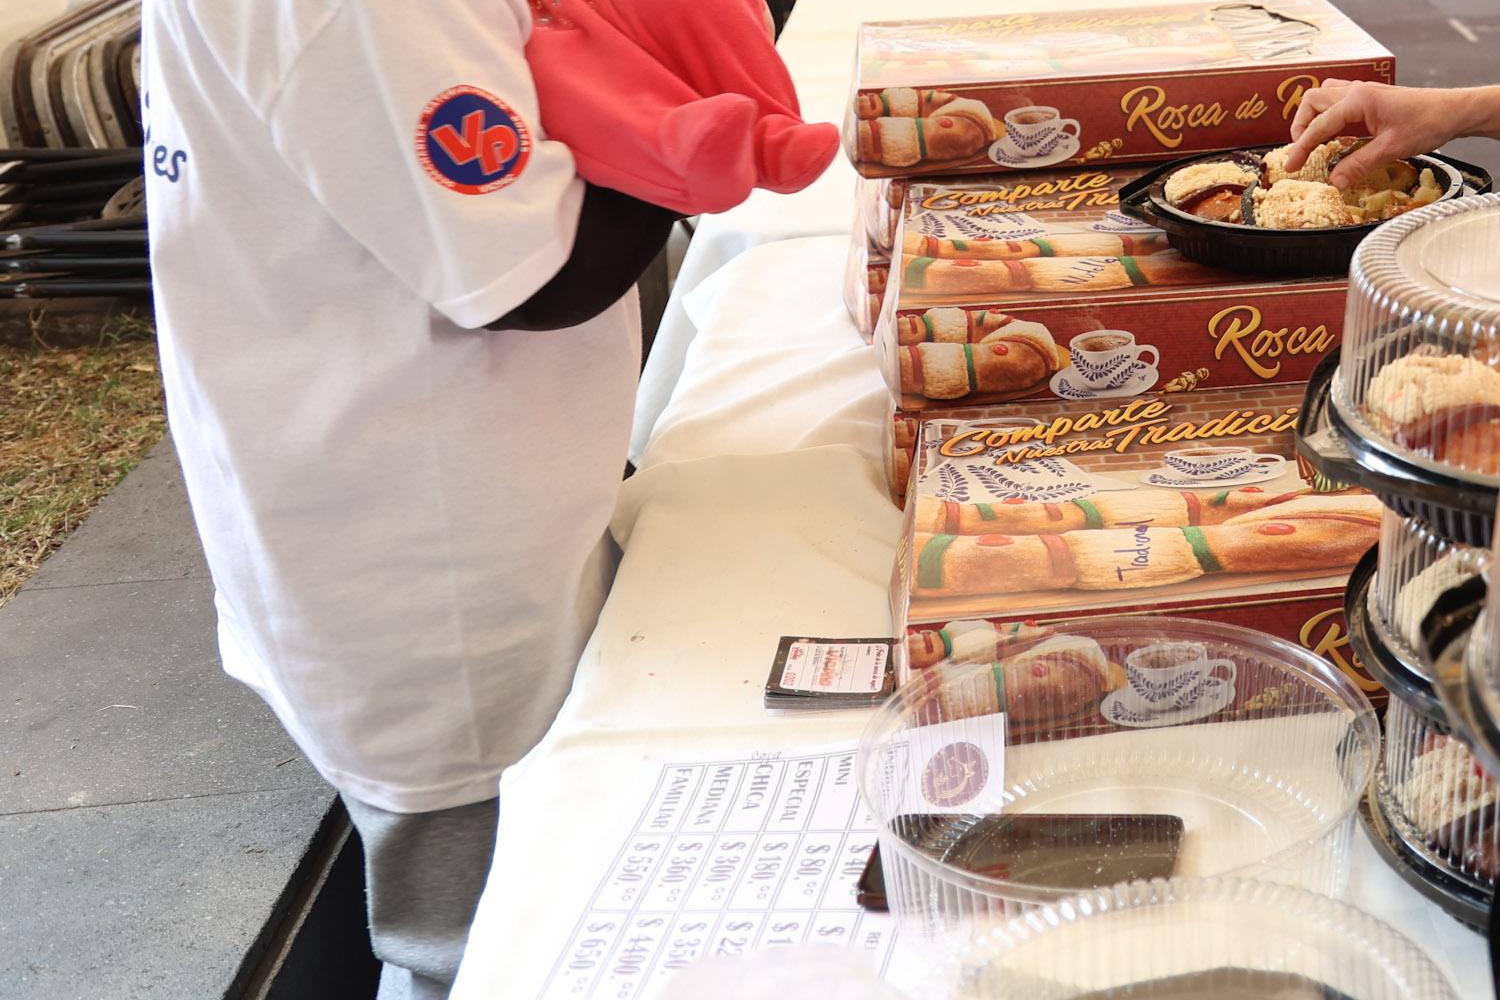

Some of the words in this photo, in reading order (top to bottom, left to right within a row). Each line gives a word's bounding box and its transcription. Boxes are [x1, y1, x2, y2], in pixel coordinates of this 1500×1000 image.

[1120, 85, 1229, 149] Rosca
[1234, 92, 1269, 120] de
[428, 109, 521, 177] VP
[921, 170, 1115, 212] Comparte
[967, 200, 1066, 218] Nuestras
[1207, 304, 1336, 380] Rosca
[939, 398, 1173, 458] Comparte
[995, 434, 1113, 466] Nuestras
[833, 755, 854, 787] MINI
[649, 767, 693, 829] FAMILIAR
[693, 765, 734, 826] MEDIANA
[741, 763, 775, 811] CHICA
[779, 760, 815, 824] ESPECIAL
[632, 841, 661, 852] $
[676, 841, 704, 853] $
[719, 840, 747, 852] $
[762, 841, 790, 853] $
[804, 844, 831, 855] $
[586, 921, 616, 934] $
[635, 917, 665, 929] $
[679, 921, 708, 933] $
[725, 920, 754, 932] $
[771, 921, 800, 933] $
